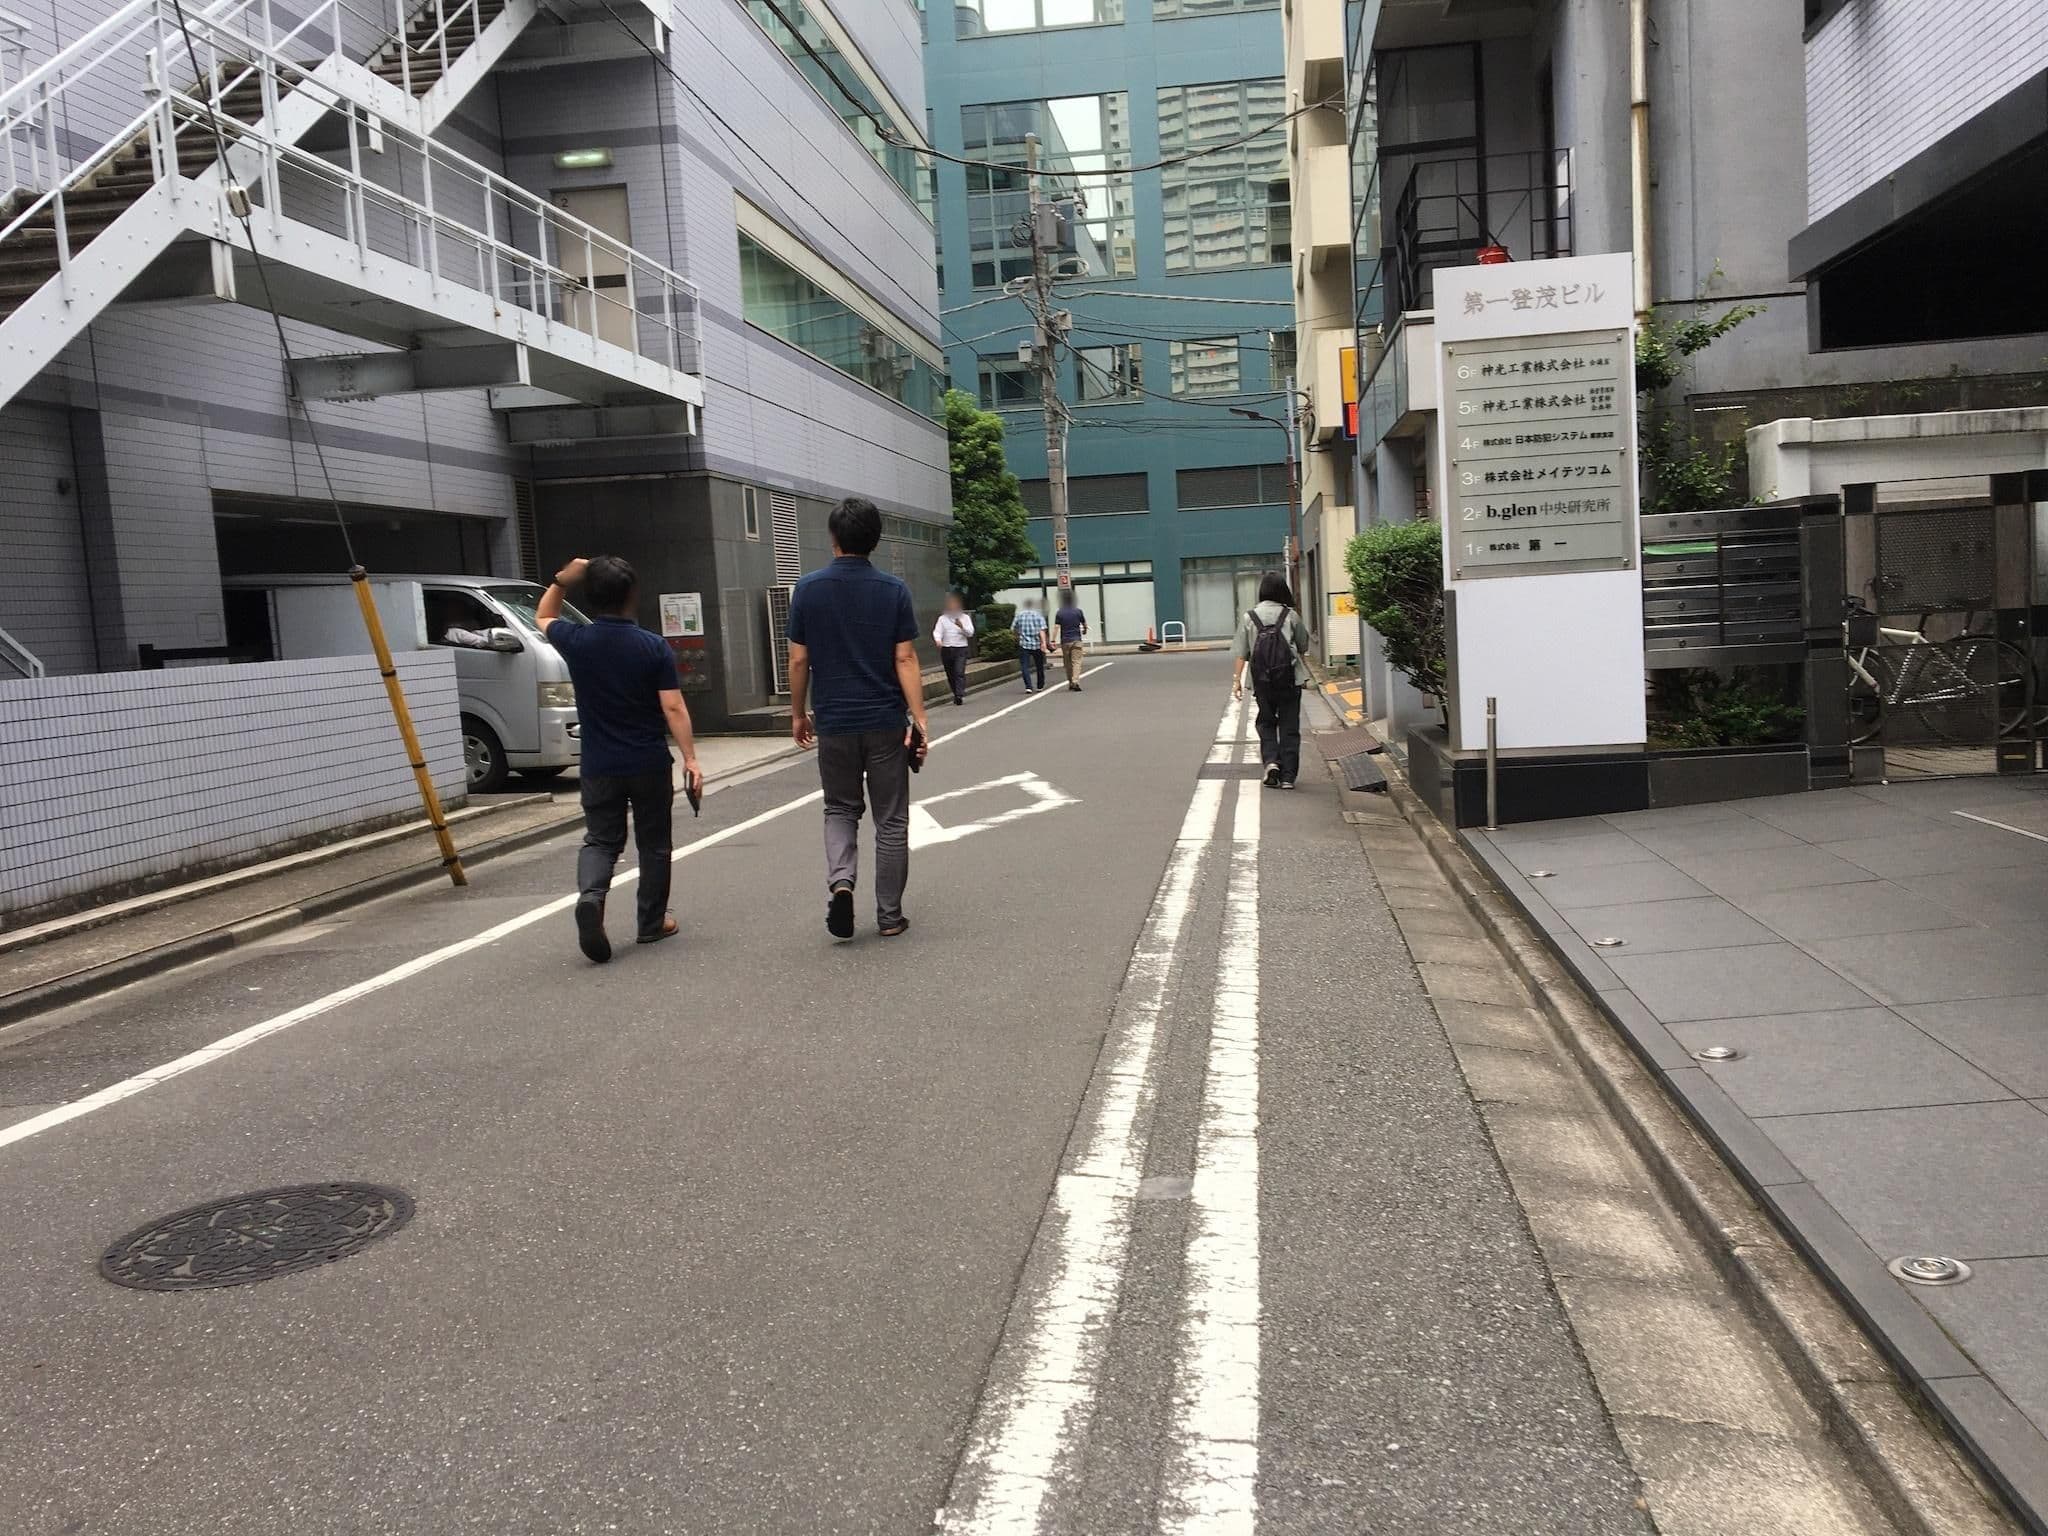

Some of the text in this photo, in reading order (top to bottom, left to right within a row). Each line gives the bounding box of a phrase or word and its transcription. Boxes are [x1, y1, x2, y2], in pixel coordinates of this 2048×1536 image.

[561, 198, 568, 207] 2
[1463, 283, 1606, 315] 第一登茂ビル
[1457, 365, 1477, 379] 6F
[1458, 401, 1478, 415] 5F
[1460, 438, 1480, 450] 4F
[1483, 438, 1512, 446] 株式会社
[1462, 464, 1612, 486] 3F 株式会社メイテツコム
[1463, 498, 1612, 521] 2F b.glen 中央研究所
[1466, 543, 1483, 556] 1F
[1489, 543, 1520, 551] 株式会社
